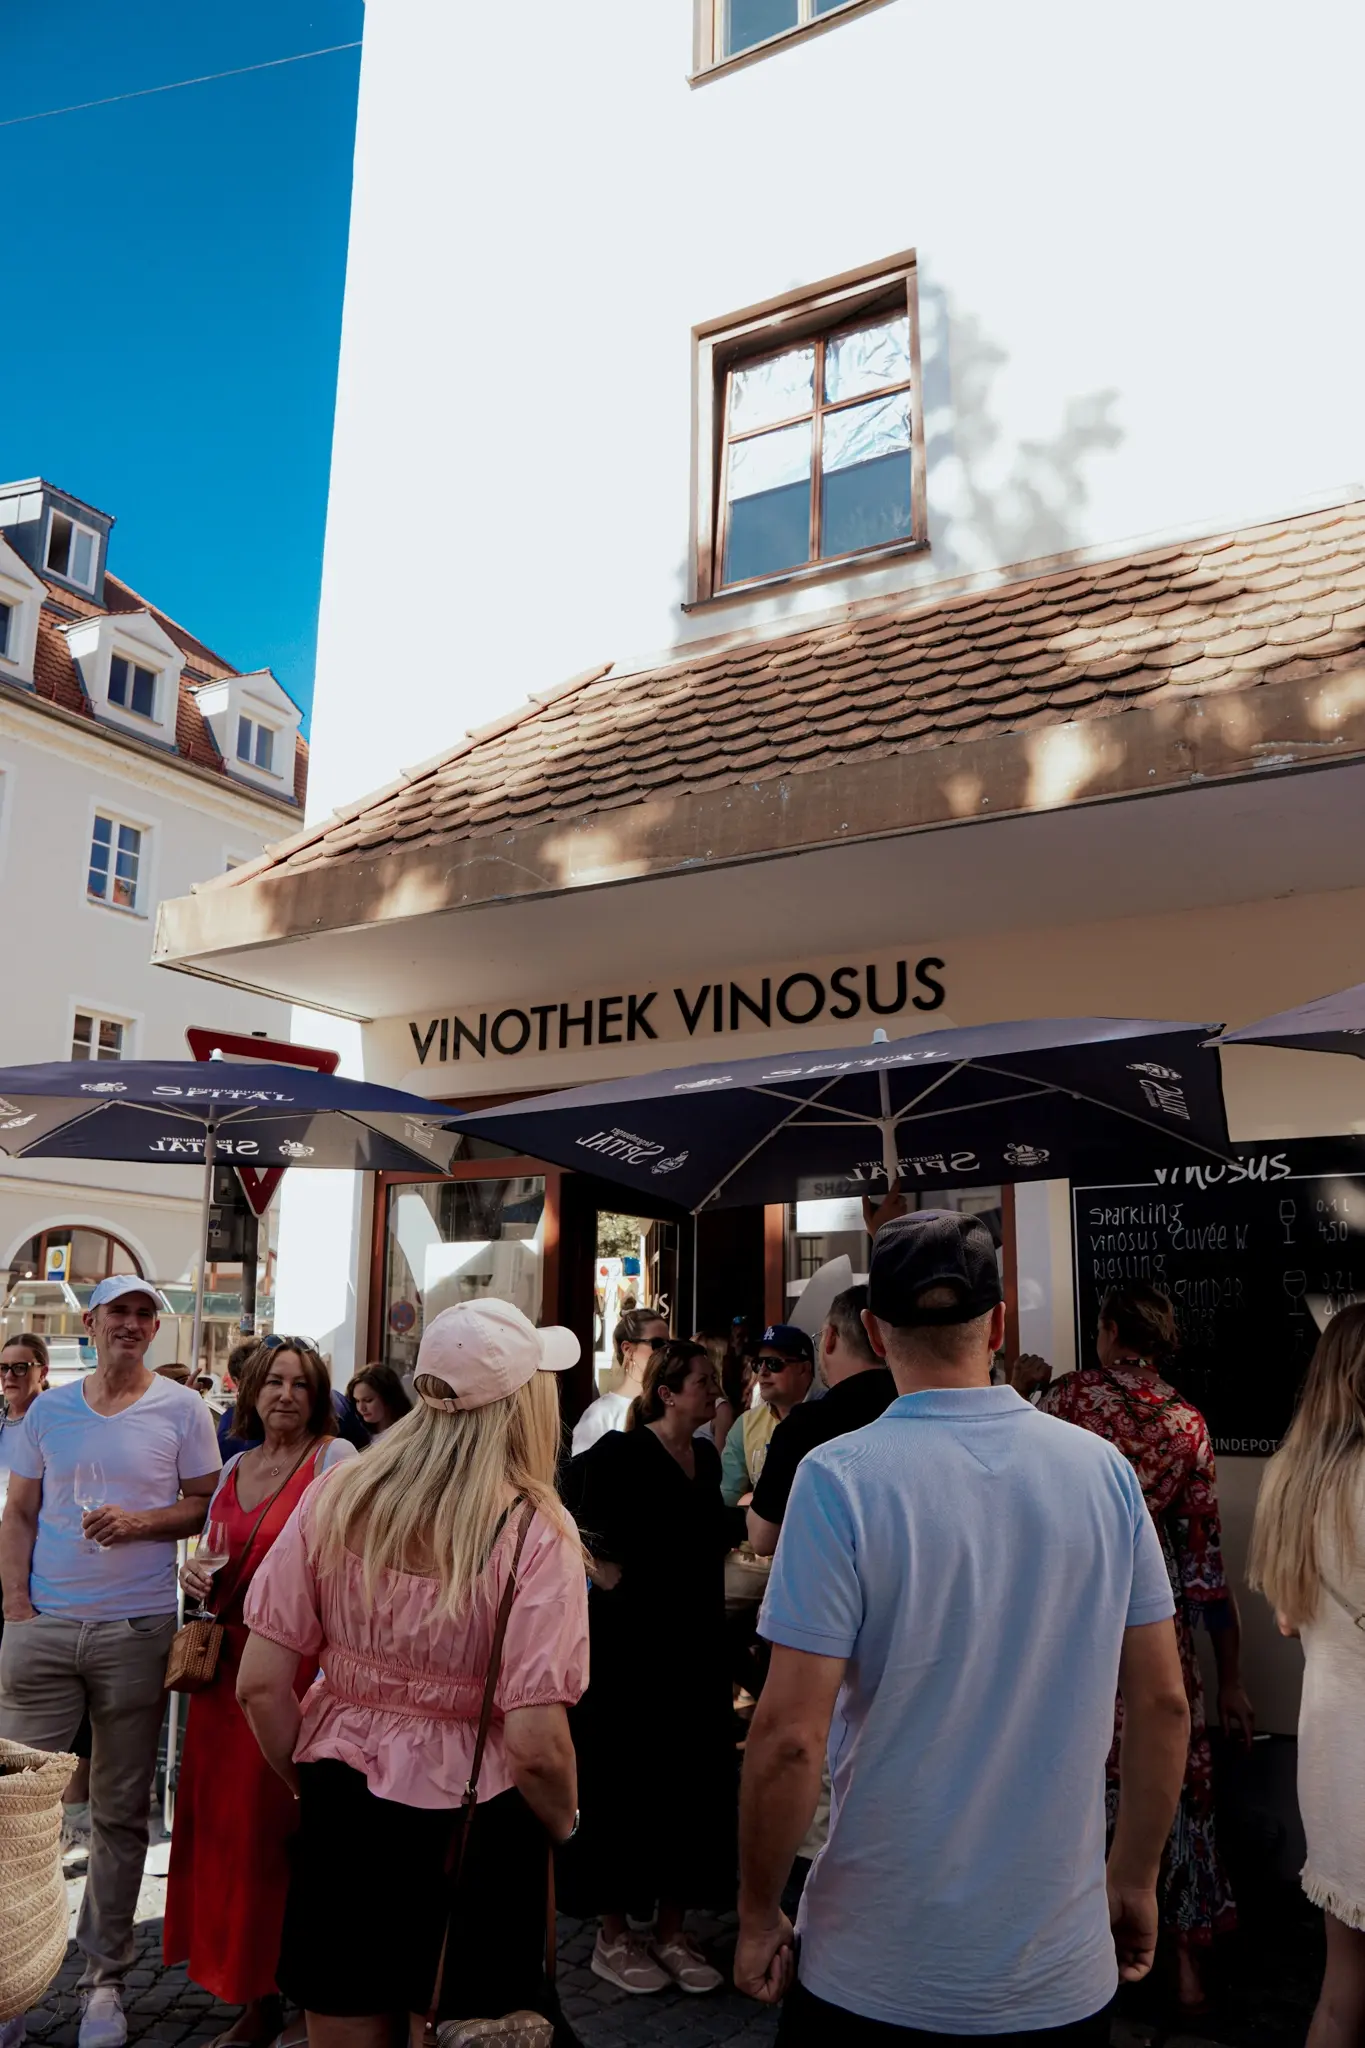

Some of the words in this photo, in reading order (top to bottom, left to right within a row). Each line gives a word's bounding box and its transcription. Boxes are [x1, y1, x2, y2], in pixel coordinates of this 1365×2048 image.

[409, 992, 658, 1065] VINOTHEK
[673, 957, 945, 1036] VINOSUS
[152, 1086, 294, 1102] SPITAL
